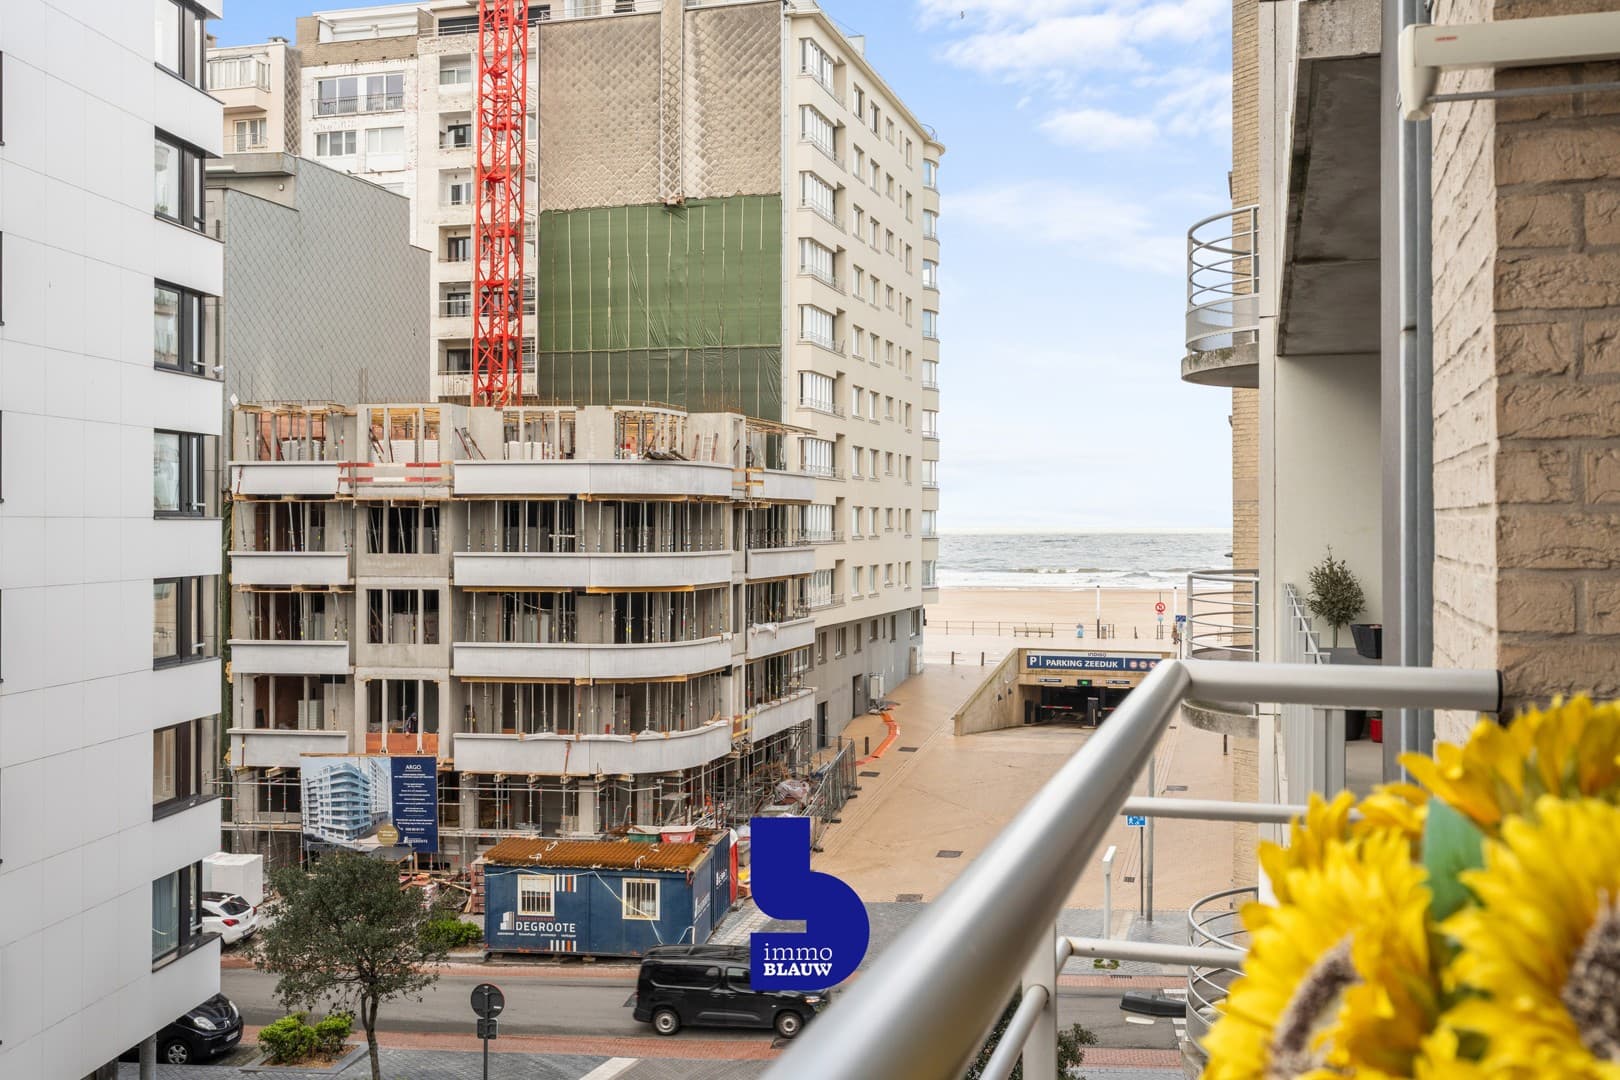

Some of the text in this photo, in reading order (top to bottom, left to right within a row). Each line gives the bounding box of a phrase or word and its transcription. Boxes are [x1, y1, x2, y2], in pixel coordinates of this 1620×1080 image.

[1029, 656, 1118, 669] P PARKING ZEEDIJK
[515, 921, 576, 933] DEGROOTE
